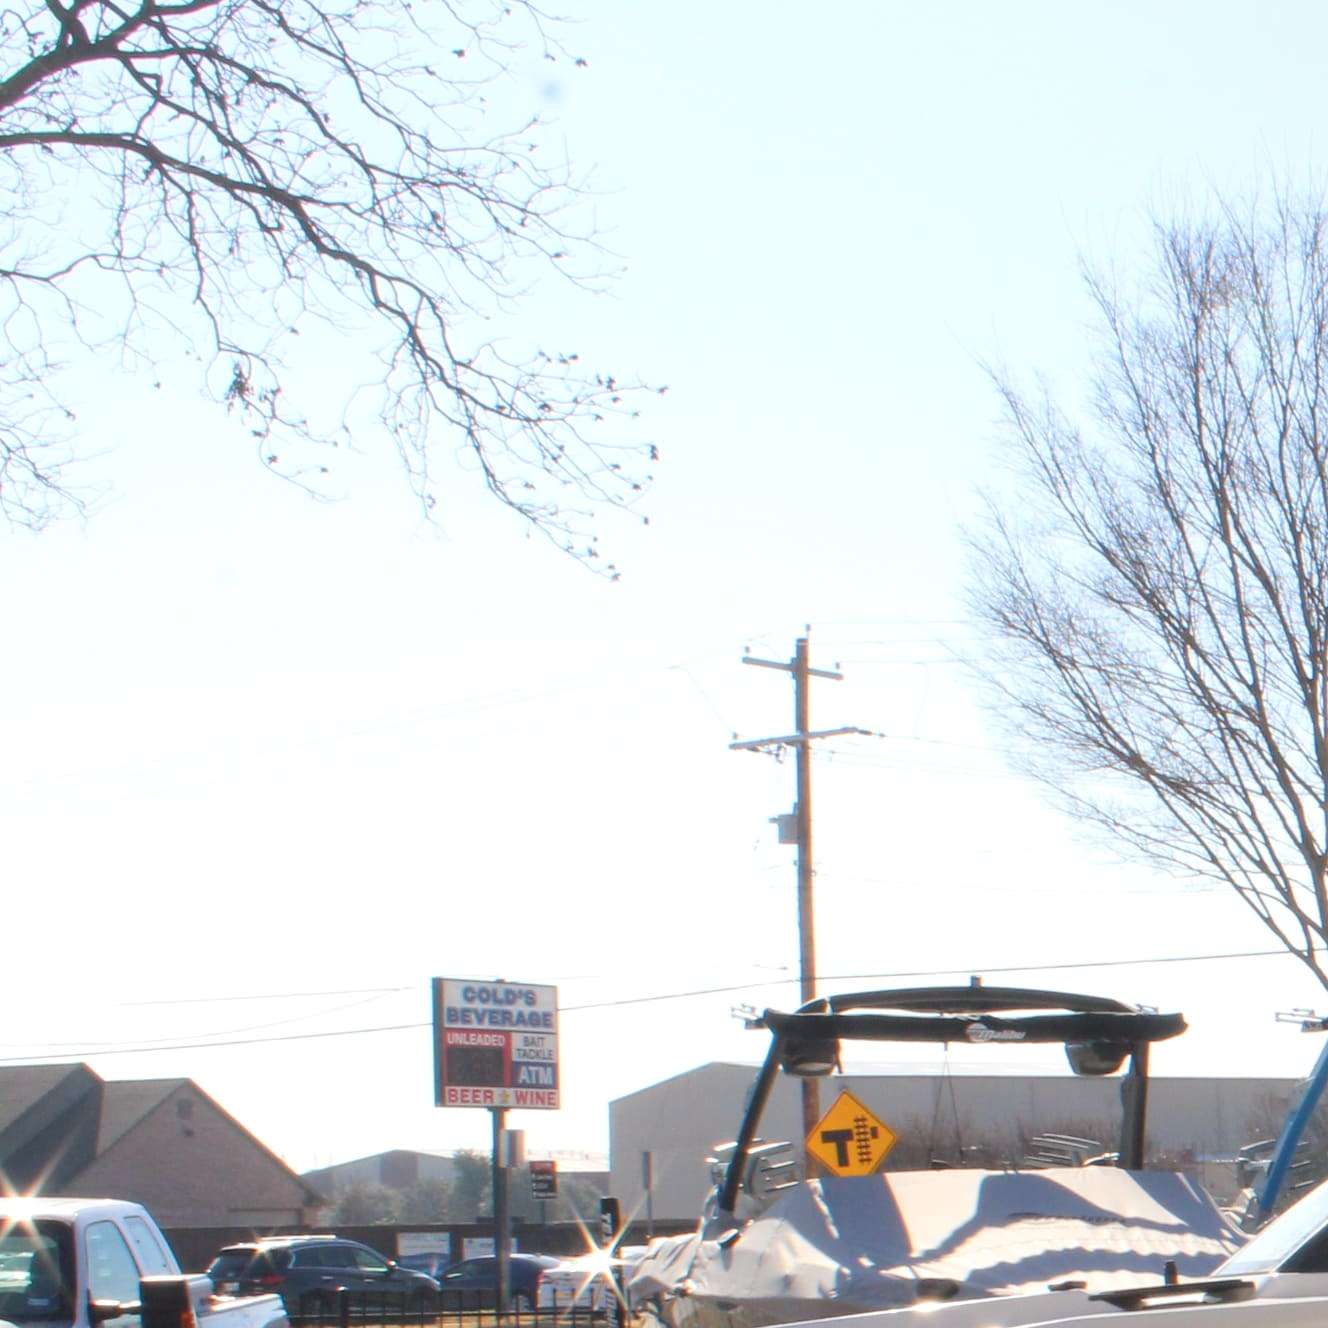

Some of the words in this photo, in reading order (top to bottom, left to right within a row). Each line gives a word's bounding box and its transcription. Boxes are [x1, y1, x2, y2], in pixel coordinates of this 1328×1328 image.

[446, 1008, 553, 1028] BEVERAGE
[447, 1033, 505, 1046] UNLEADED
[523, 1036, 545, 1048] BAIT
[517, 1048, 553, 1061] TACKLE
[519, 1066, 553, 1085] ATM
[448, 1089, 494, 1104] BEER
[515, 1090, 556, 1106] WINE
